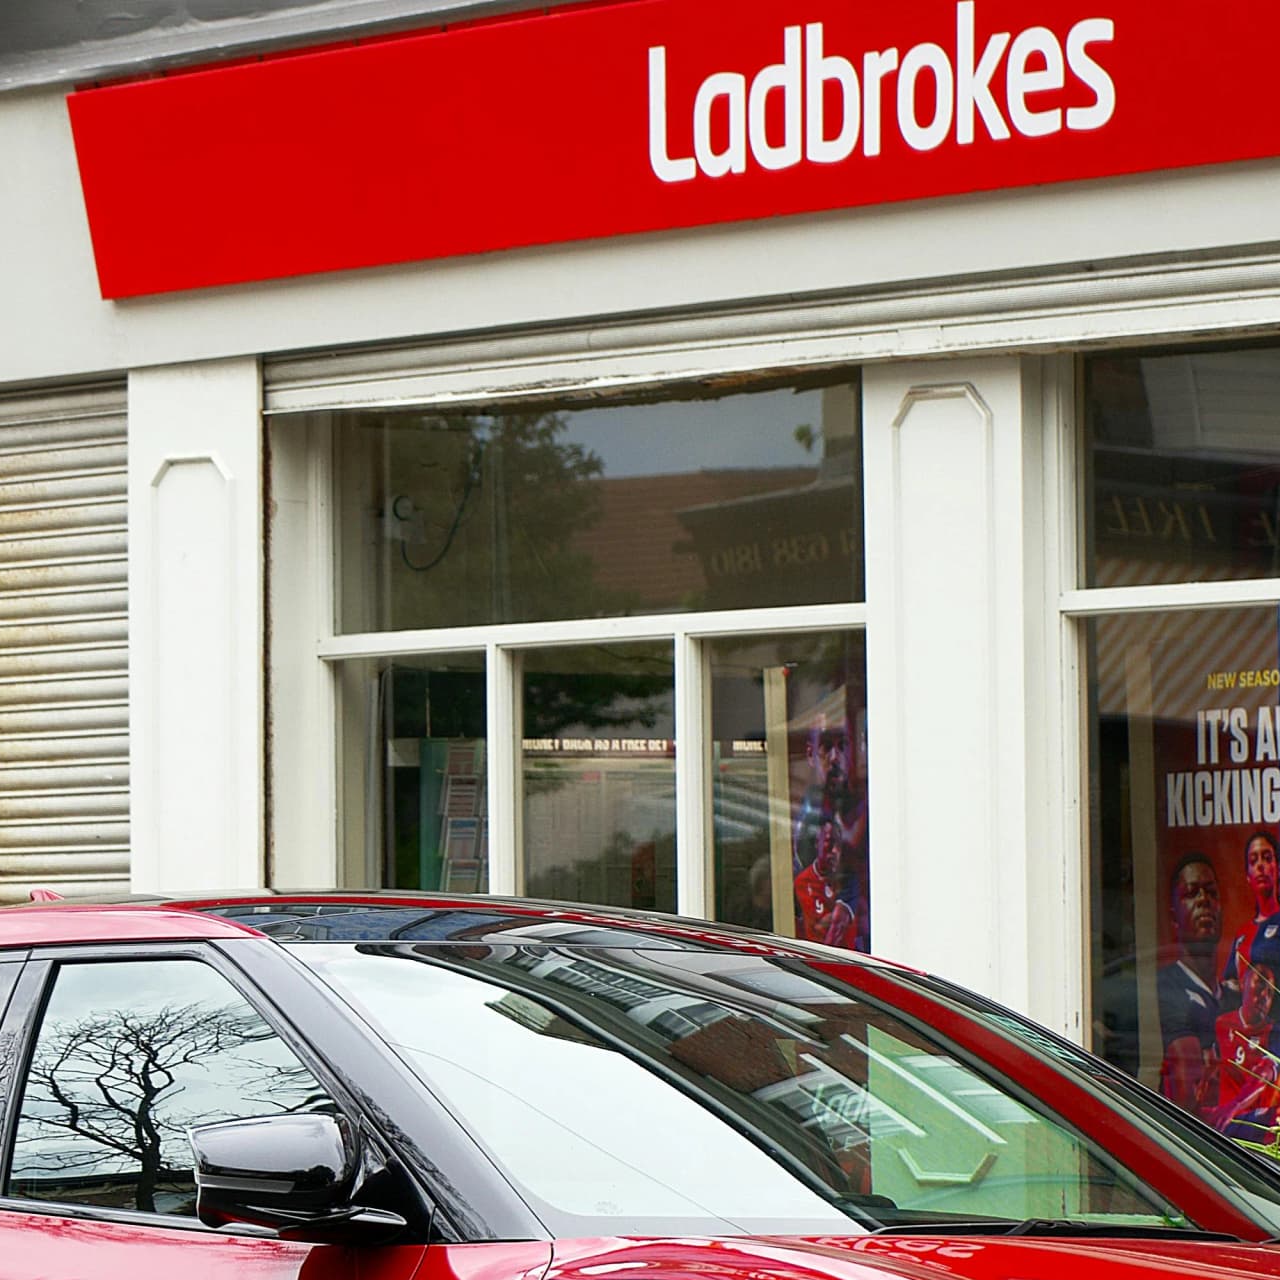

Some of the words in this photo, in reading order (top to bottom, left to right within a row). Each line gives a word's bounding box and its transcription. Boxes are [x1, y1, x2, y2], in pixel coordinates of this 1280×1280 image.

[648, 1, 1116, 183] Ladbrokes
[1207, 673, 1237, 689] NEW
[1239, 669, 1280, 688] SEASO
[1235, 1047, 1245, 1064] 9
